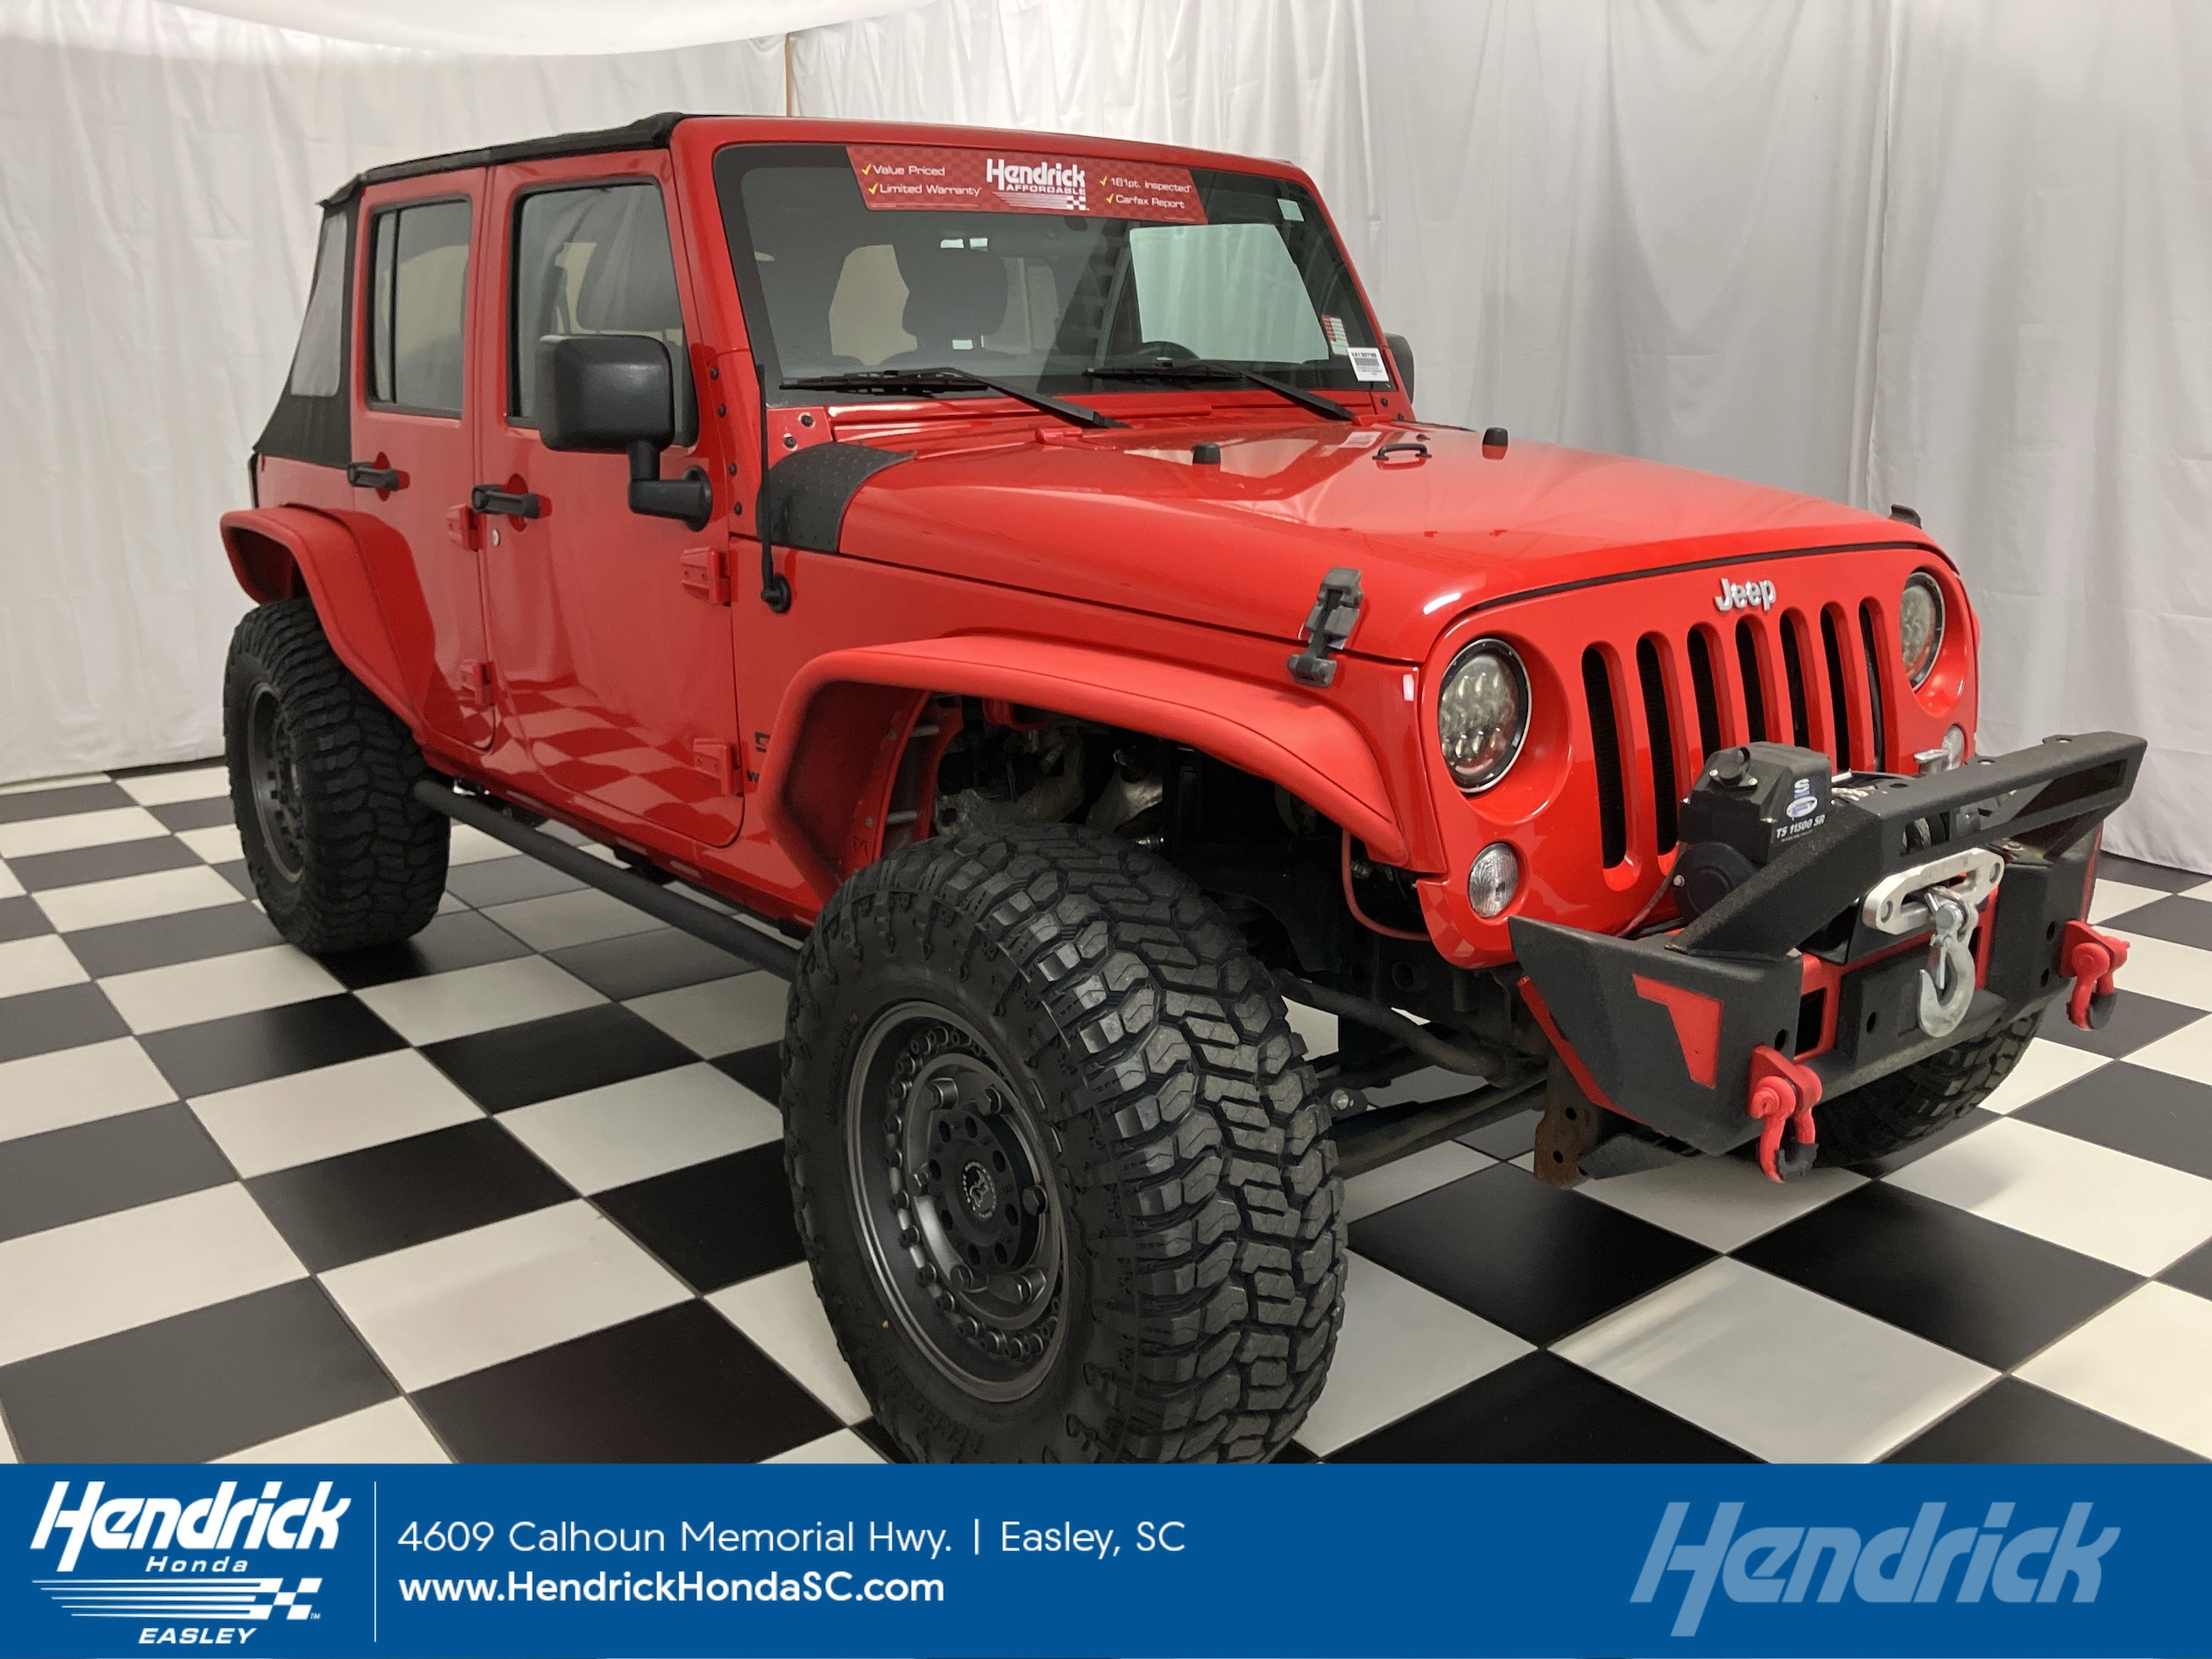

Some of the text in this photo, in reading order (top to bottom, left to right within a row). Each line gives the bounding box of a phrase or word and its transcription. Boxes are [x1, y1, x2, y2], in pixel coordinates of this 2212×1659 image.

[872, 165, 945, 176] Value Priced
[987, 158, 1086, 191] Hendrick
[879, 183, 922, 194] Limited
[1006, 183, 1086, 196] AFFORDABLE
[1116, 194, 1185, 209] Carfax Report
[1715, 577, 1777, 611] Jeep
[1776, 826, 1787, 839] TS
[1813, 814, 1826, 827] SR
